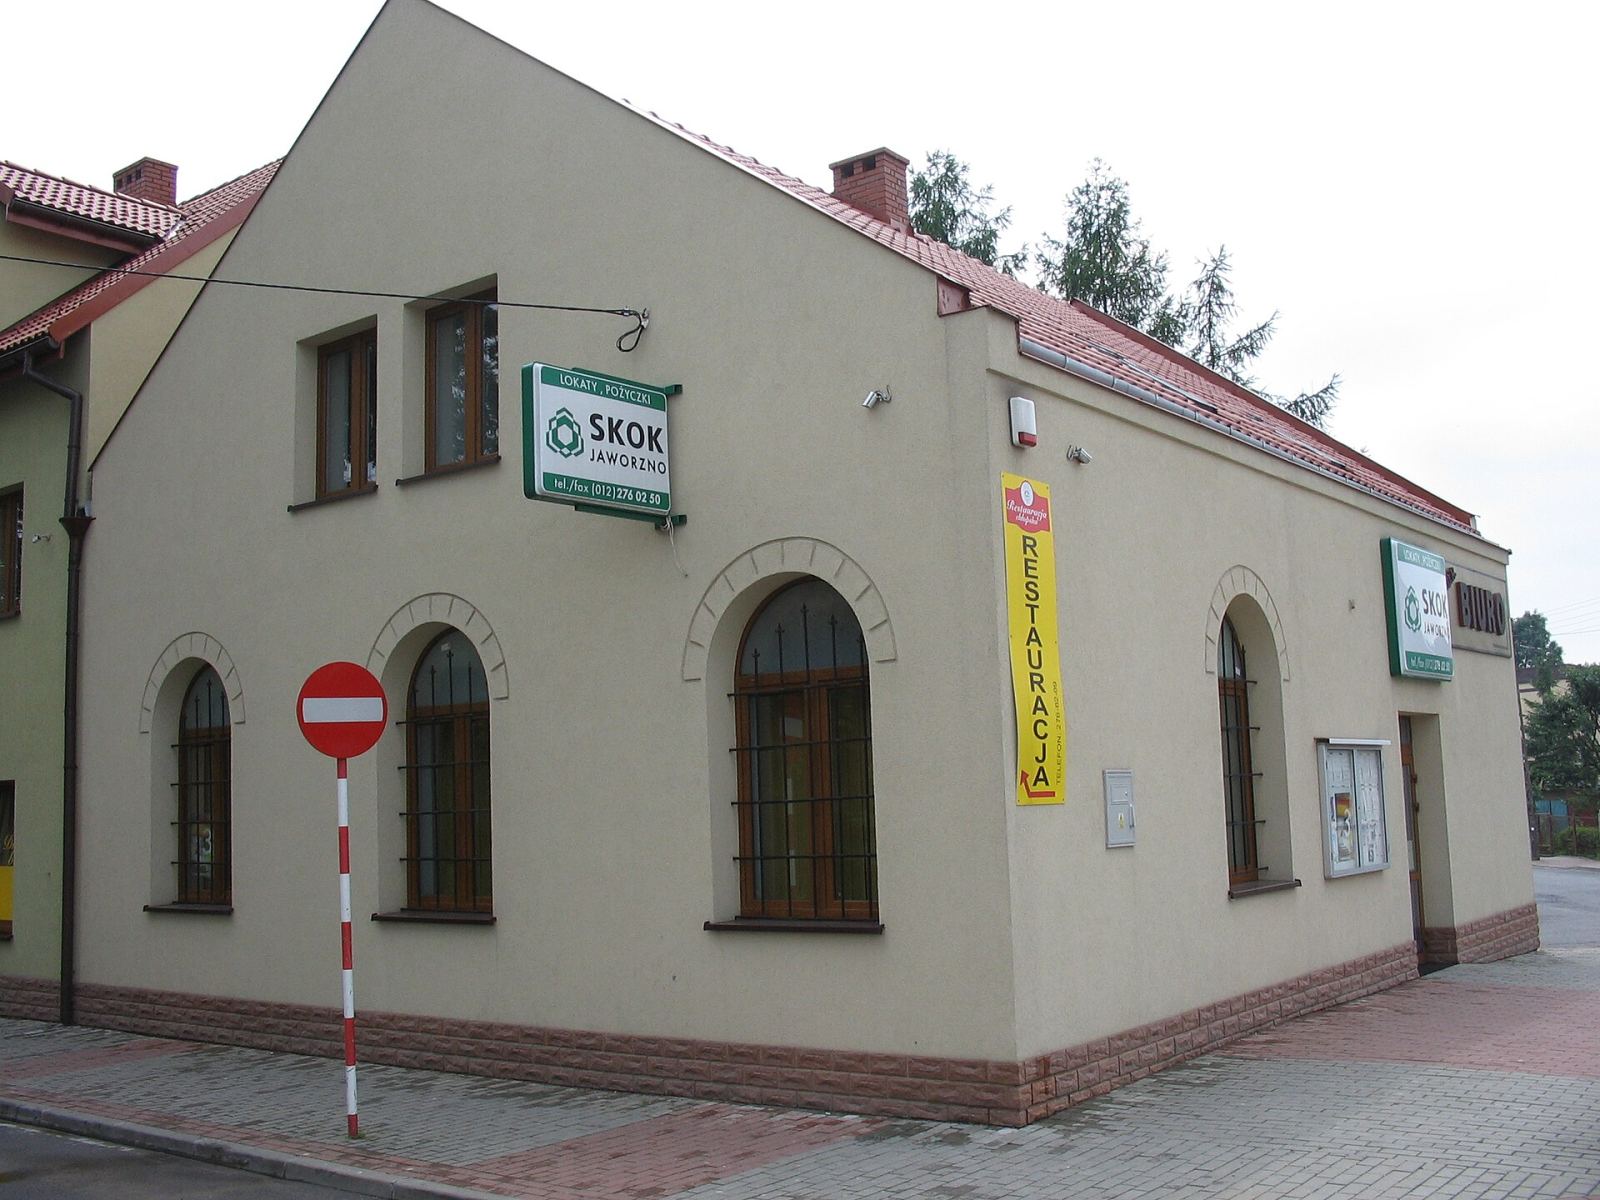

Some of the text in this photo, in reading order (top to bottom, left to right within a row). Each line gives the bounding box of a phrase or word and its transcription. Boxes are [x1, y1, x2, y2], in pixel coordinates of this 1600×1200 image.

[605, 384, 652, 405] POŻYCZKI
[589, 413, 664, 454] SKOK
[589, 448, 667, 475] JAWORZNO
[636, 490, 647, 503] 02
[649, 493, 661, 505] 50
[1421, 588, 1448, 619] SKOK
[1456, 581, 1506, 636] BIURO
[1021, 534, 1050, 787] RESTAURACJA
